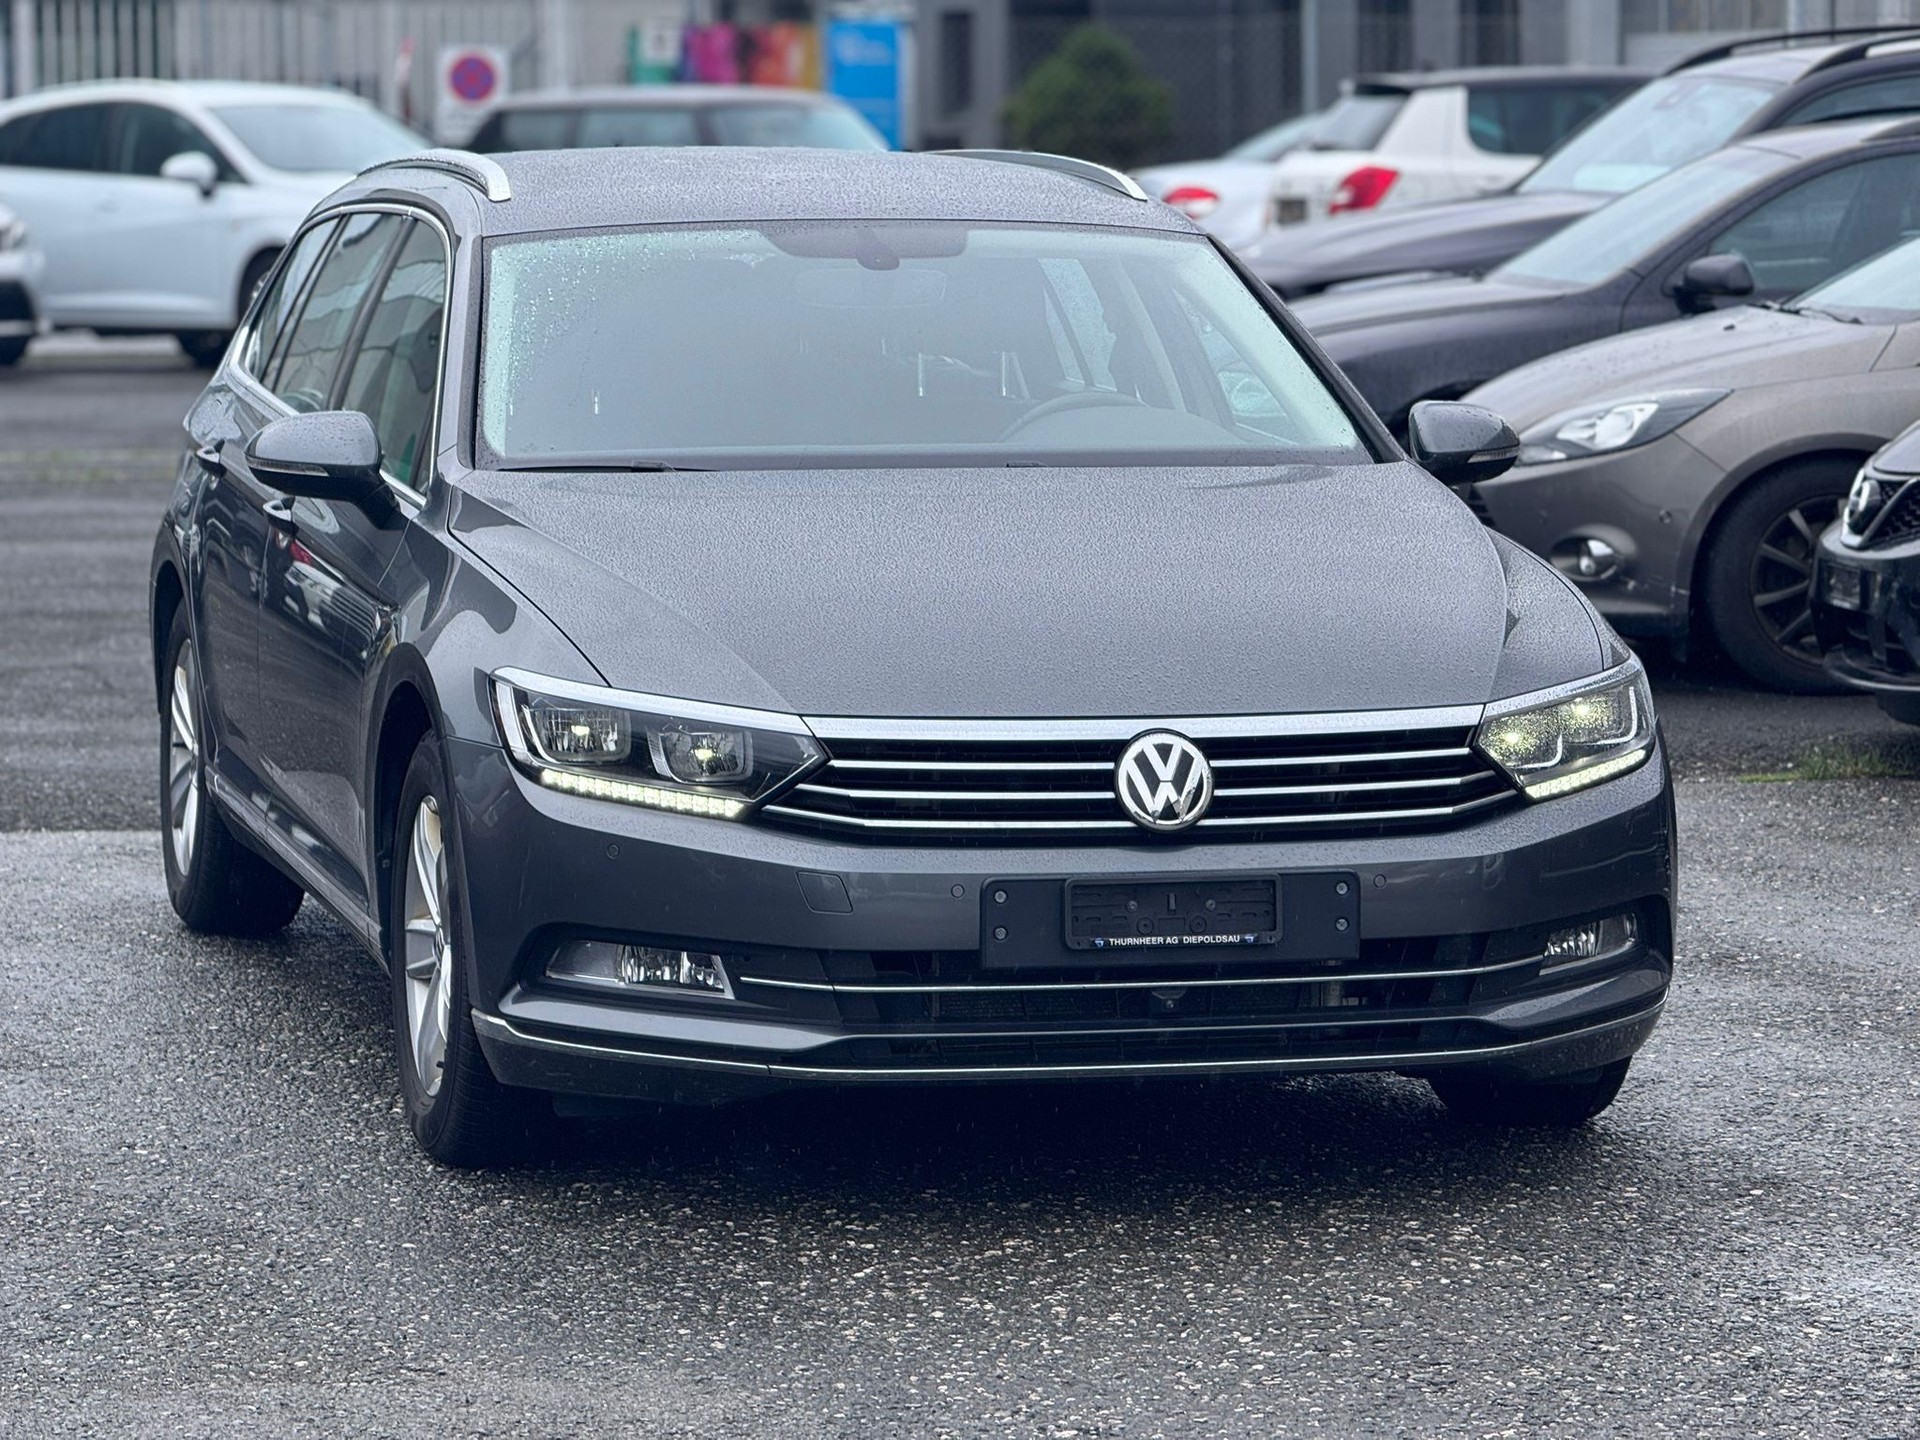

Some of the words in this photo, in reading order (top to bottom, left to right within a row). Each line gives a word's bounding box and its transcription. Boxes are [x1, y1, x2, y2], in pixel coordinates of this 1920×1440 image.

[1120, 735, 1210, 825] VW
[1109, 936, 1164, 946] THURNHEER
[1165, 936, 1179, 945] AG
[1182, 935, 1240, 945] DIEPOLDSAU
